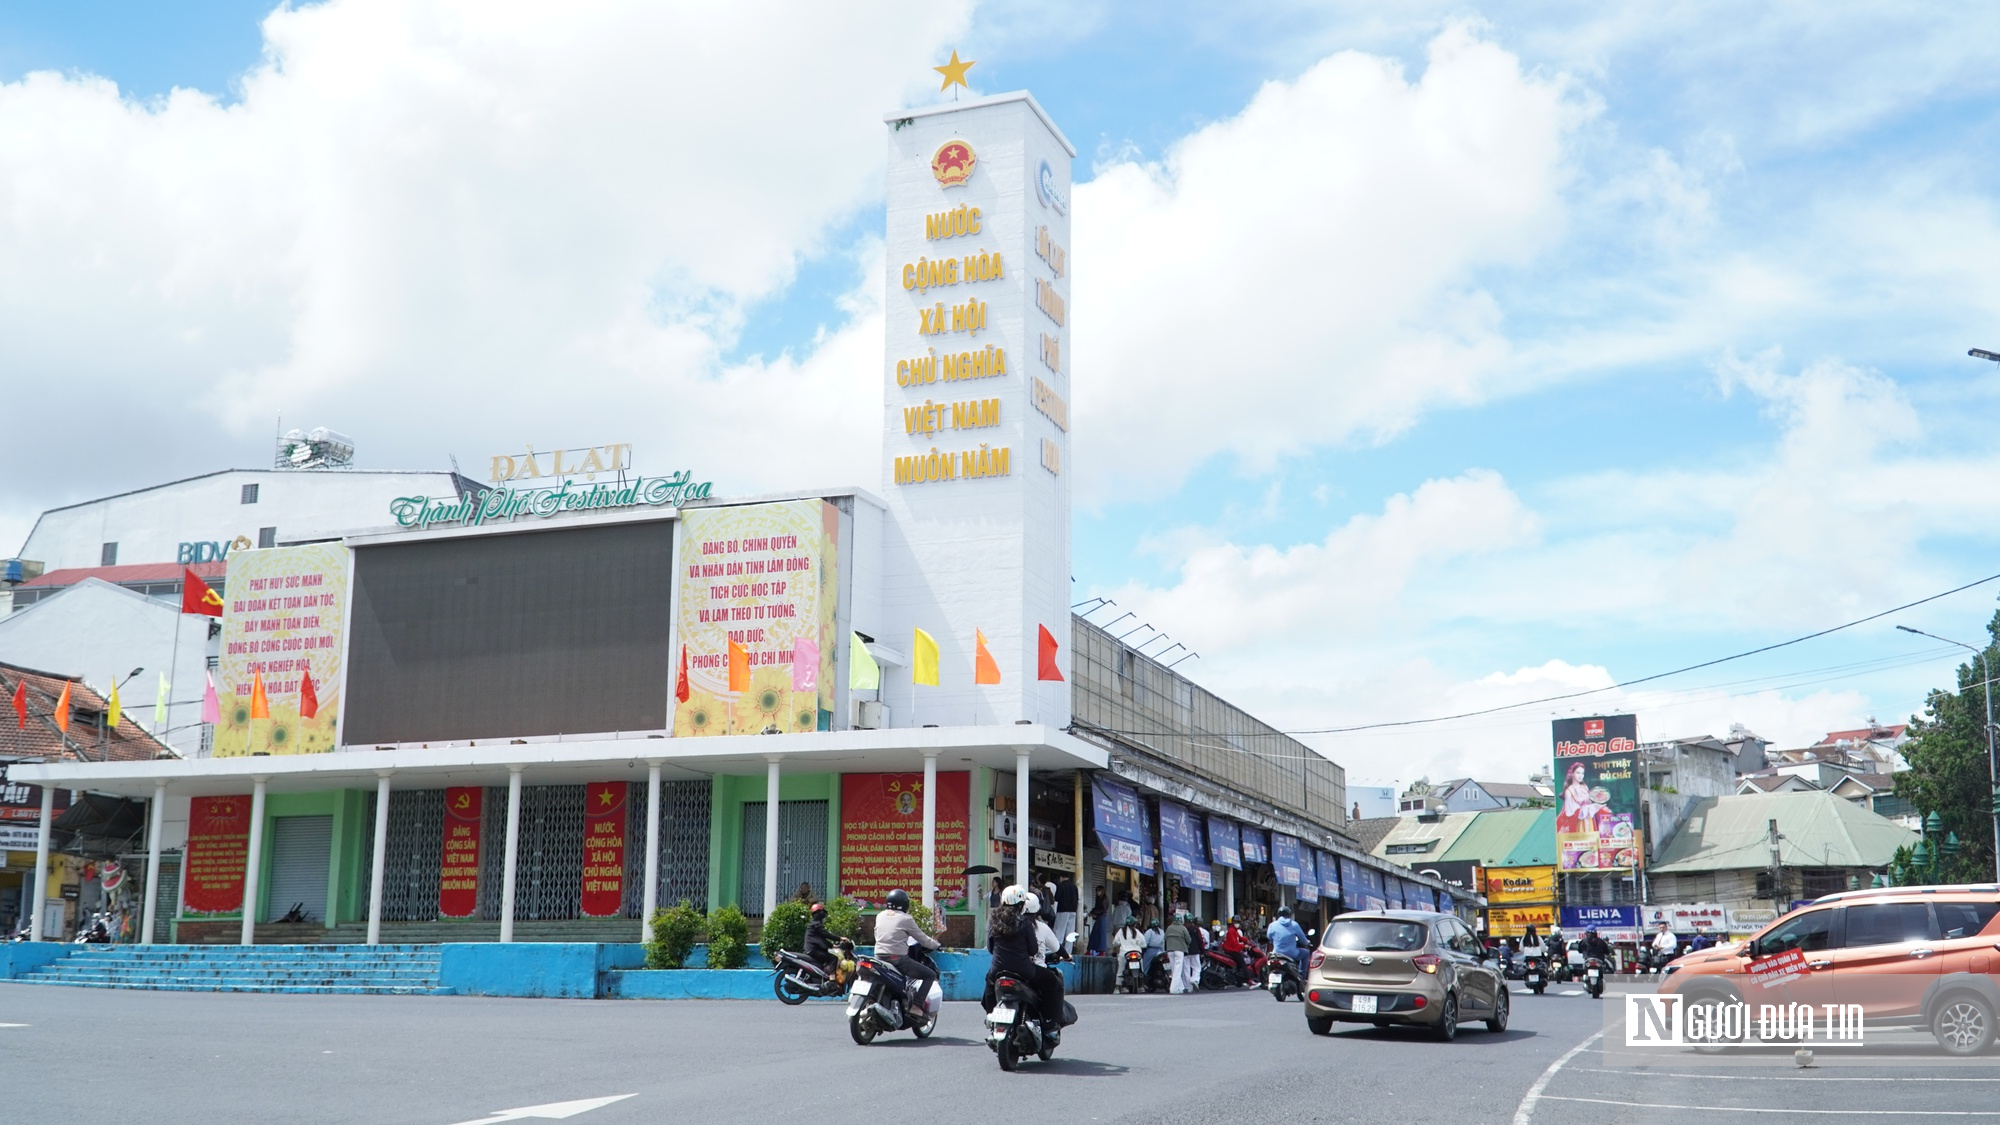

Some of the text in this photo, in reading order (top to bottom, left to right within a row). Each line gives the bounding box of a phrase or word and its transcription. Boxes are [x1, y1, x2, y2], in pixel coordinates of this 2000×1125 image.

[926, 203, 982, 240] NƯỚC
[903, 248, 1004, 294] CỘNG HÒA
[919, 297, 987, 337] XÃ HỘI
[896, 344, 1007, 387] CHỦ NGHĨA
[903, 398, 1000, 438] VIỆT NAM
[488, 442, 632, 482] ĐÀ LẠT
[894, 442, 1011, 485] MUÔN NĂM
[390, 469, 714, 529] Thành Phố Festival Hoa
[703, 531, 797, 555] ĐẢNG BỘ, CHÍNH QUYỀN
[177, 540, 232, 564] BIDV
[689, 553, 809, 578] VÀ NHÂN DÂN TỈNH LÂM ĐỒNG
[269, 576, 284, 590] HUY
[710, 580, 787, 600] TÍCH CỰC HỌC TẬP
[268, 594, 281, 611] KẾT
[699, 602, 797, 622] VÀ LÀM THEO TƯ TƯỞNG,
[261, 638, 280, 652] CÔNG
[692, 654, 720, 669] PHONG
[761, 650, 776, 665] CHÍ
[1556, 737, 1635, 757] Hoàng Gia
[1593, 758, 1632, 770] THỊT THẬT
[1600, 769, 1632, 780] ĐỦ CHẤT
[453, 825, 470, 837] ĐẢNG
[594, 821, 616, 834] NƯỚC
[844, 822, 857, 831] HỌC
[858, 821, 869, 831] TẬP
[870, 820, 877, 829] VÀ
[891, 821, 905, 829] THEO
[586, 835, 623, 850] CỘNG HÒA
[867, 832, 885, 840] CÁCH
[886, 831, 894, 840] HỒ
[446, 838, 476, 852] CỘNG SẢN
[884, 844, 898, 853] CHỊU
[899, 844, 918, 852] TRÁCH
[447, 852, 475, 866] VIỆT NAM
[591, 850, 616, 865] XÃ HỘI
[442, 866, 478, 878] QUANG VINH
[583, 864, 622, 877] CHỦ NGHĨA
[442, 878, 476, 890] MUÔN NĂM
[585, 879, 619, 894] VIỆT NAM
[1503, 877, 1533, 886] Kodak
[1778, 968, 1786, 976] XE
